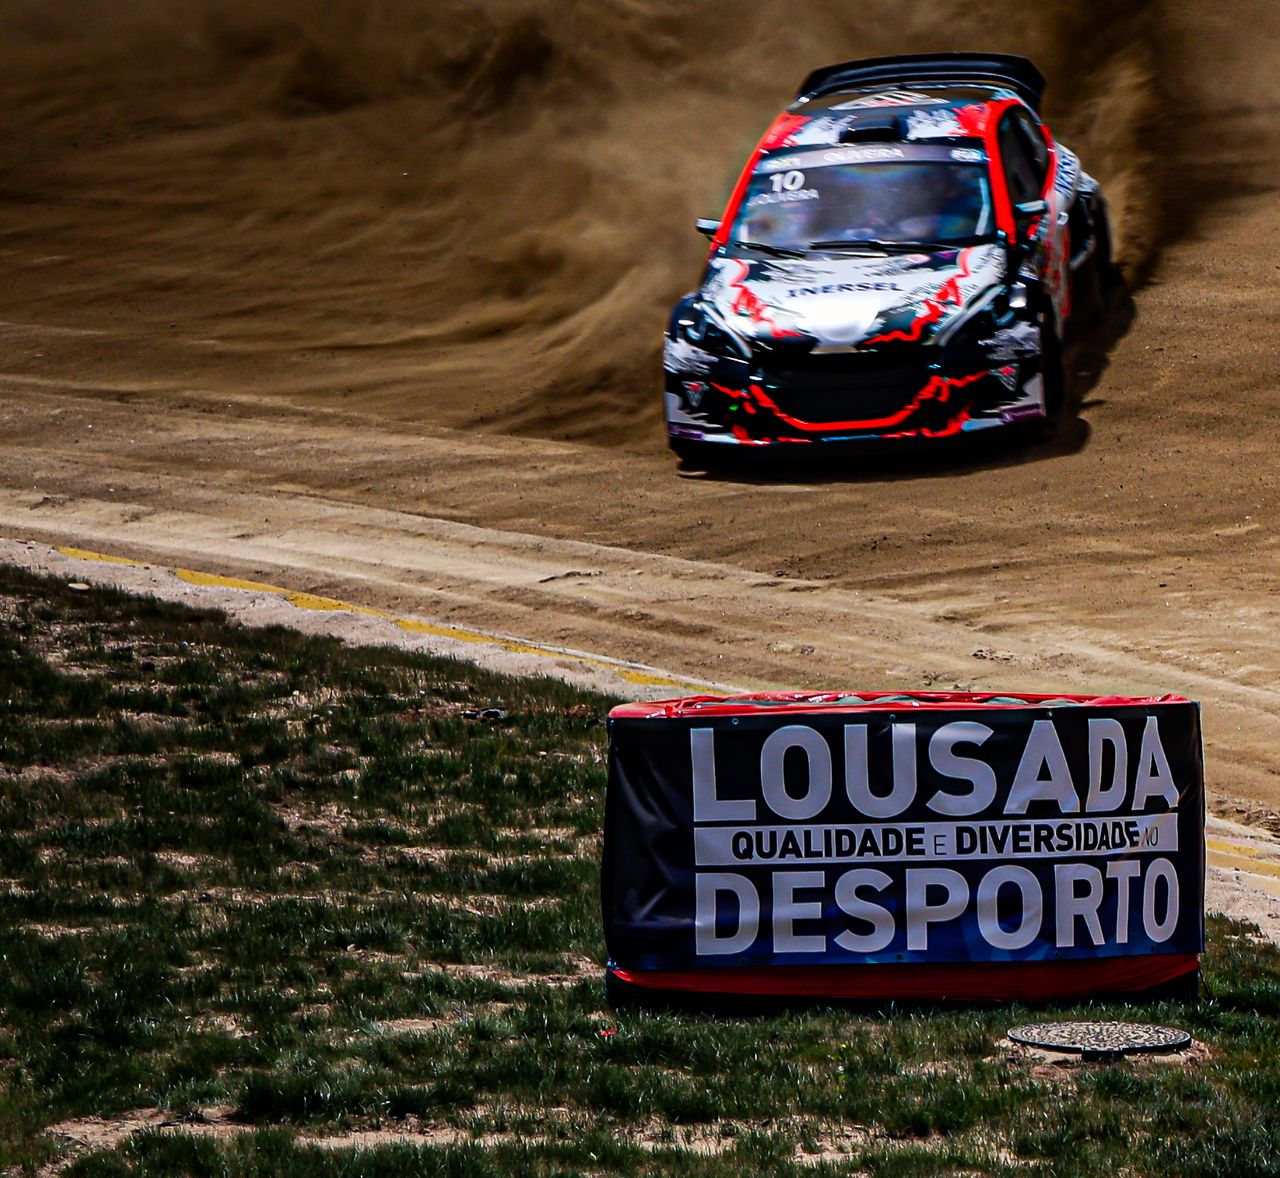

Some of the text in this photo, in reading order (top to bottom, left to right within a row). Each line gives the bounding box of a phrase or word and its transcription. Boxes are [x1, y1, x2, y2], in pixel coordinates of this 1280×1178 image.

[769, 170, 805, 192] 10
[787, 283, 903, 297] INERSEL
[690, 715, 1180, 822] LOUSADA
[731, 826, 926, 860] QUALIDADE
[933, 834, 948, 856] E
[955, 820, 1141, 855] DIVERSIDADE
[695, 857, 1180, 956] DESPORTO
